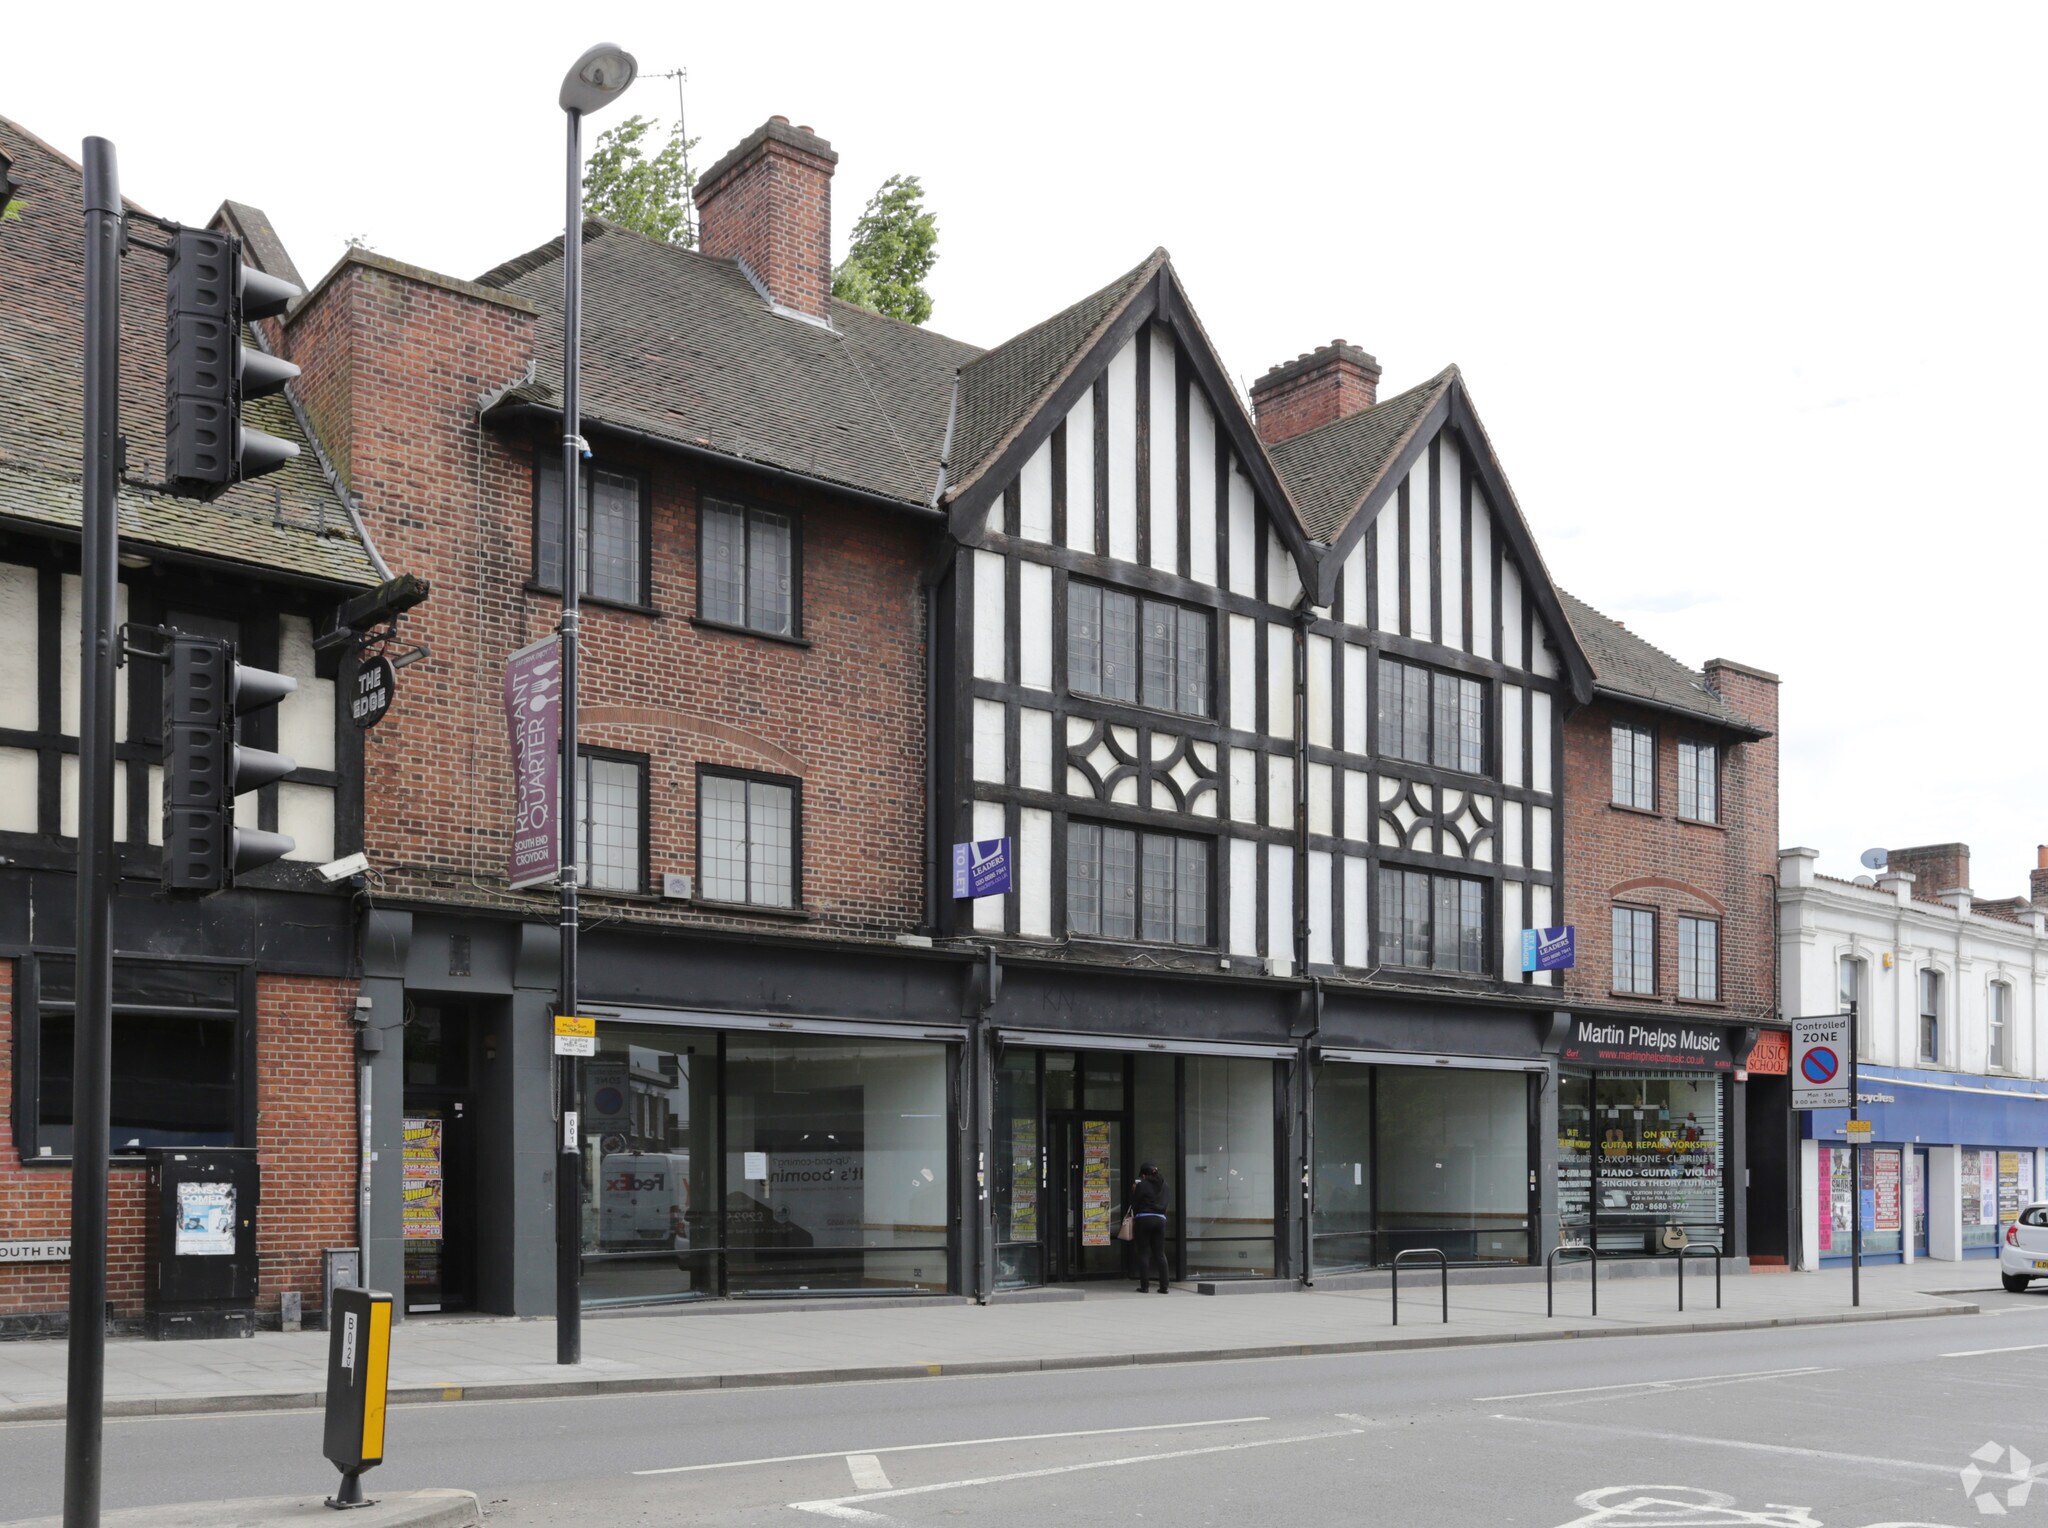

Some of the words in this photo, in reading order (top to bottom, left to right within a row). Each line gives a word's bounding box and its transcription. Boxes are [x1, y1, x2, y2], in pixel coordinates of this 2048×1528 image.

[358, 666, 381, 694] THE
[353, 687, 386, 718] EDGE
[512, 673, 529, 834] RESTAURANT
[528, 716, 549, 830] QUARTER
[515, 838, 535, 852] SOUTH
[536, 835, 548, 846] END
[516, 849, 549, 866] CROYDON
[956, 846, 966, 866] TO
[972, 854, 1004, 877] LEADERS
[956, 869, 966, 894] LET
[1540, 938, 1570, 956] LEADERS
[1796, 1020, 1846, 1031] Controlled
[1578, 1021, 1624, 1044] Martin
[1628, 1026, 1676, 1052] Phelps
[1680, 1030, 1720, 1052] Music
[1803, 1032, 1838, 1042] ZONE
[1599, 1050, 1705, 1065] www.martinphelpsmusic.co.uk
[1750, 1044, 1786, 1060] MUSIC
[1748, 1058, 1786, 1072] SCHOOL
[1644, 1130, 1657, 1138] ON
[1660, 1130, 1677, 1138] SITE
[1598, 1154, 1660, 1164] SAXOPHONE
[1666, 1154, 1714, 1163] CLARINET
[1641, 1168, 1678, 1176] GUITAR
[182, 1194, 228, 1203] COMED
[0, 1247, 40, 1258] OUTH
[48, 1246, 71, 1256] EN
